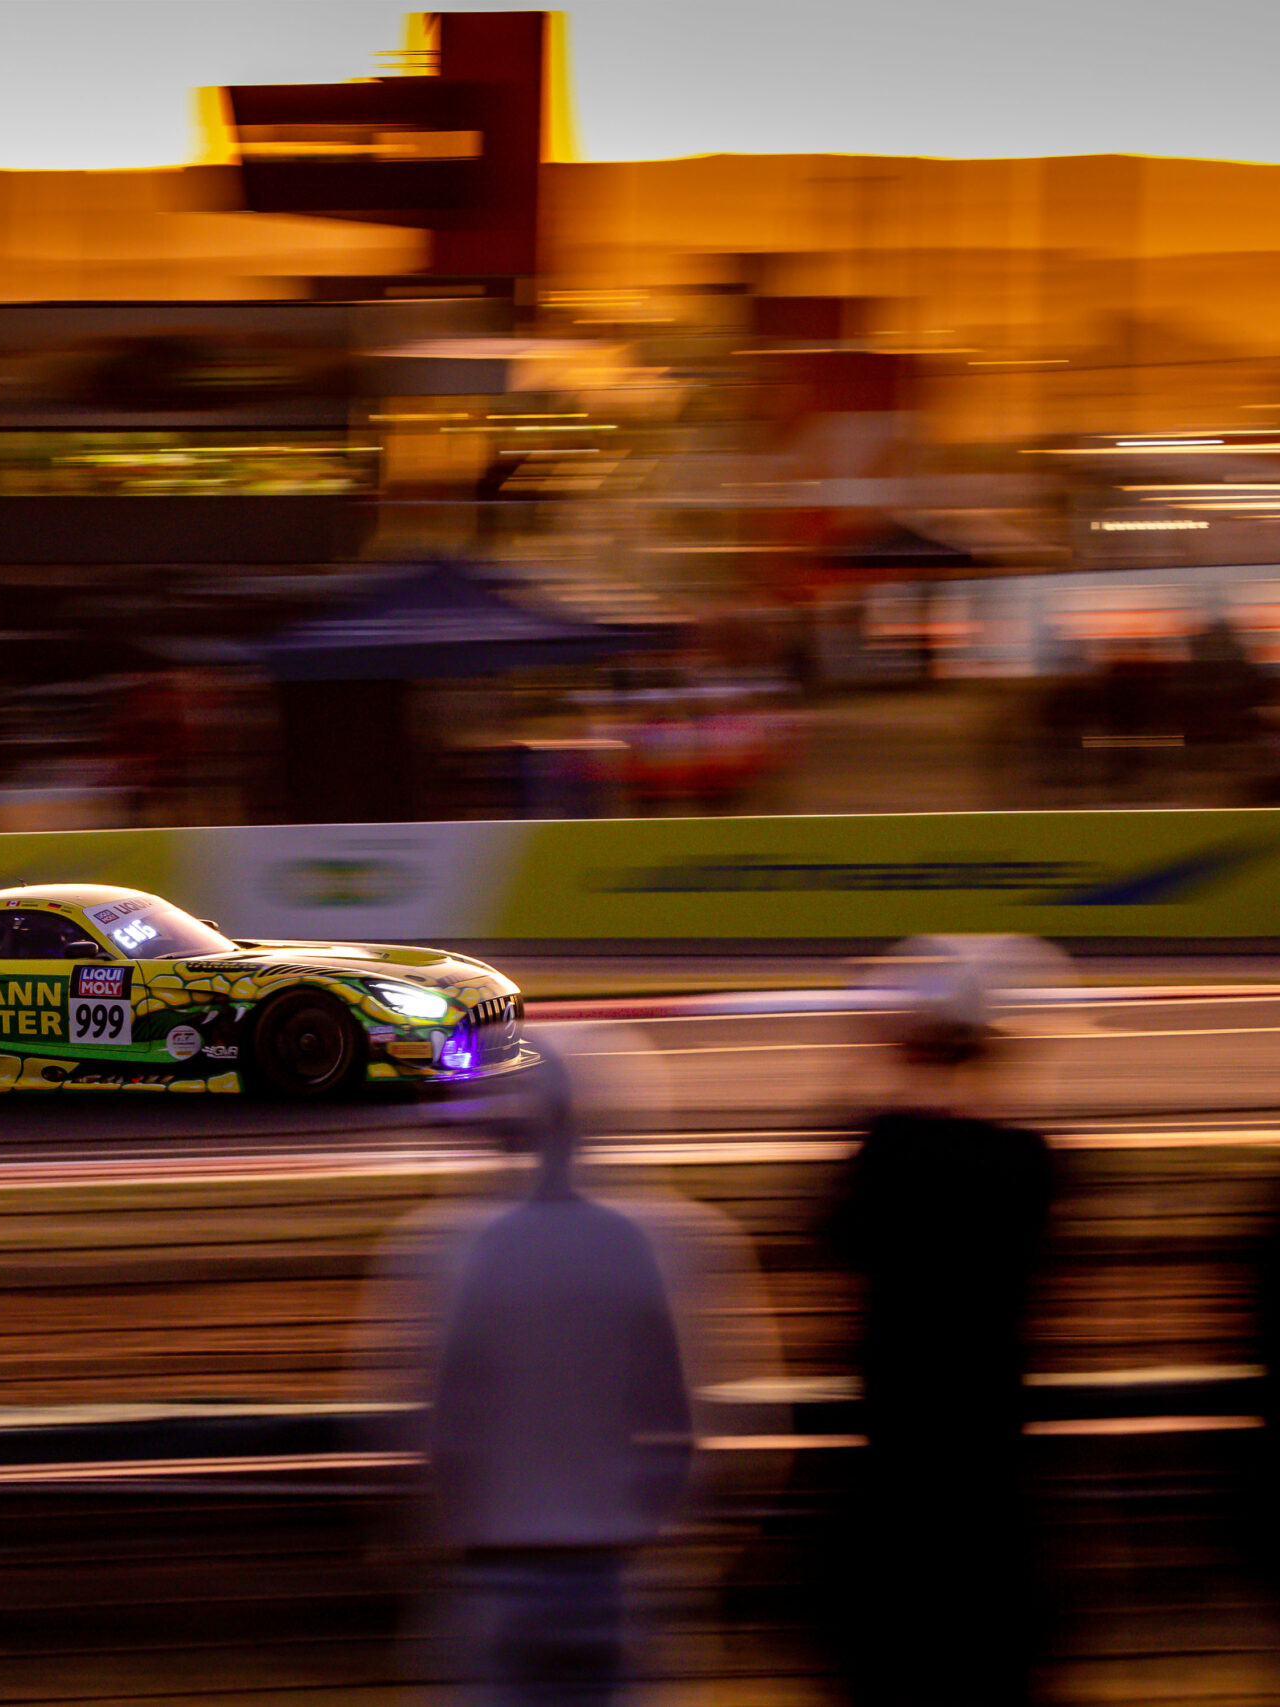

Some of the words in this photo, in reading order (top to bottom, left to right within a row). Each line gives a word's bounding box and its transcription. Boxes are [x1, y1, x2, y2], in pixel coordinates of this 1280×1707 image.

[82, 968, 122, 981] LIQUI
[81, 981, 121, 994] MOLY
[76, 1003, 125, 1039] 999
